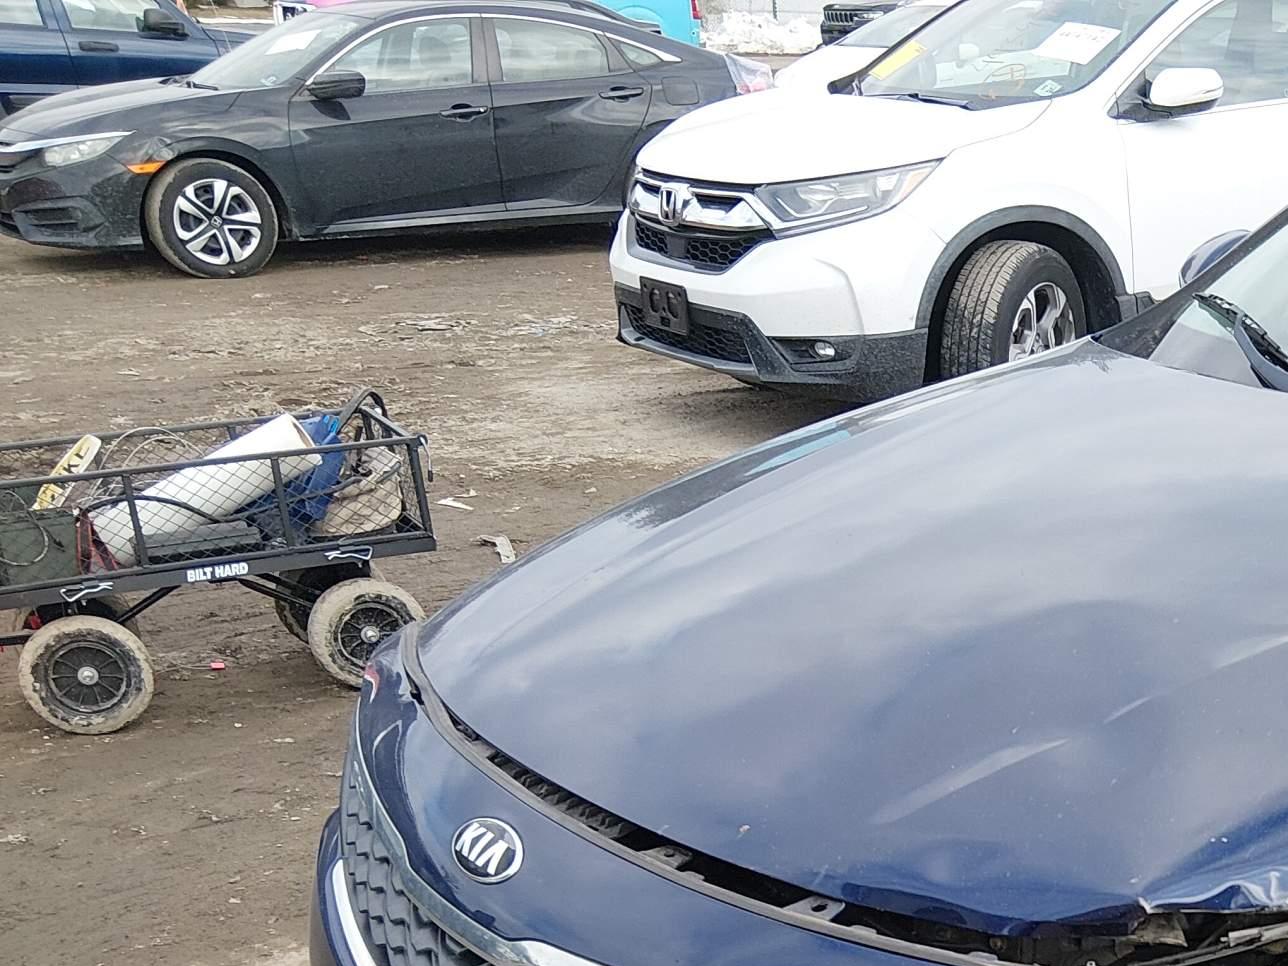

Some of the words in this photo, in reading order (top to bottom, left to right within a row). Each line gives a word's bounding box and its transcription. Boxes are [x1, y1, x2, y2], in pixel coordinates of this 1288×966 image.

[187, 567, 213, 582] BILT
[214, 562, 249, 578] HARD
[455, 822, 509, 875] KIA
